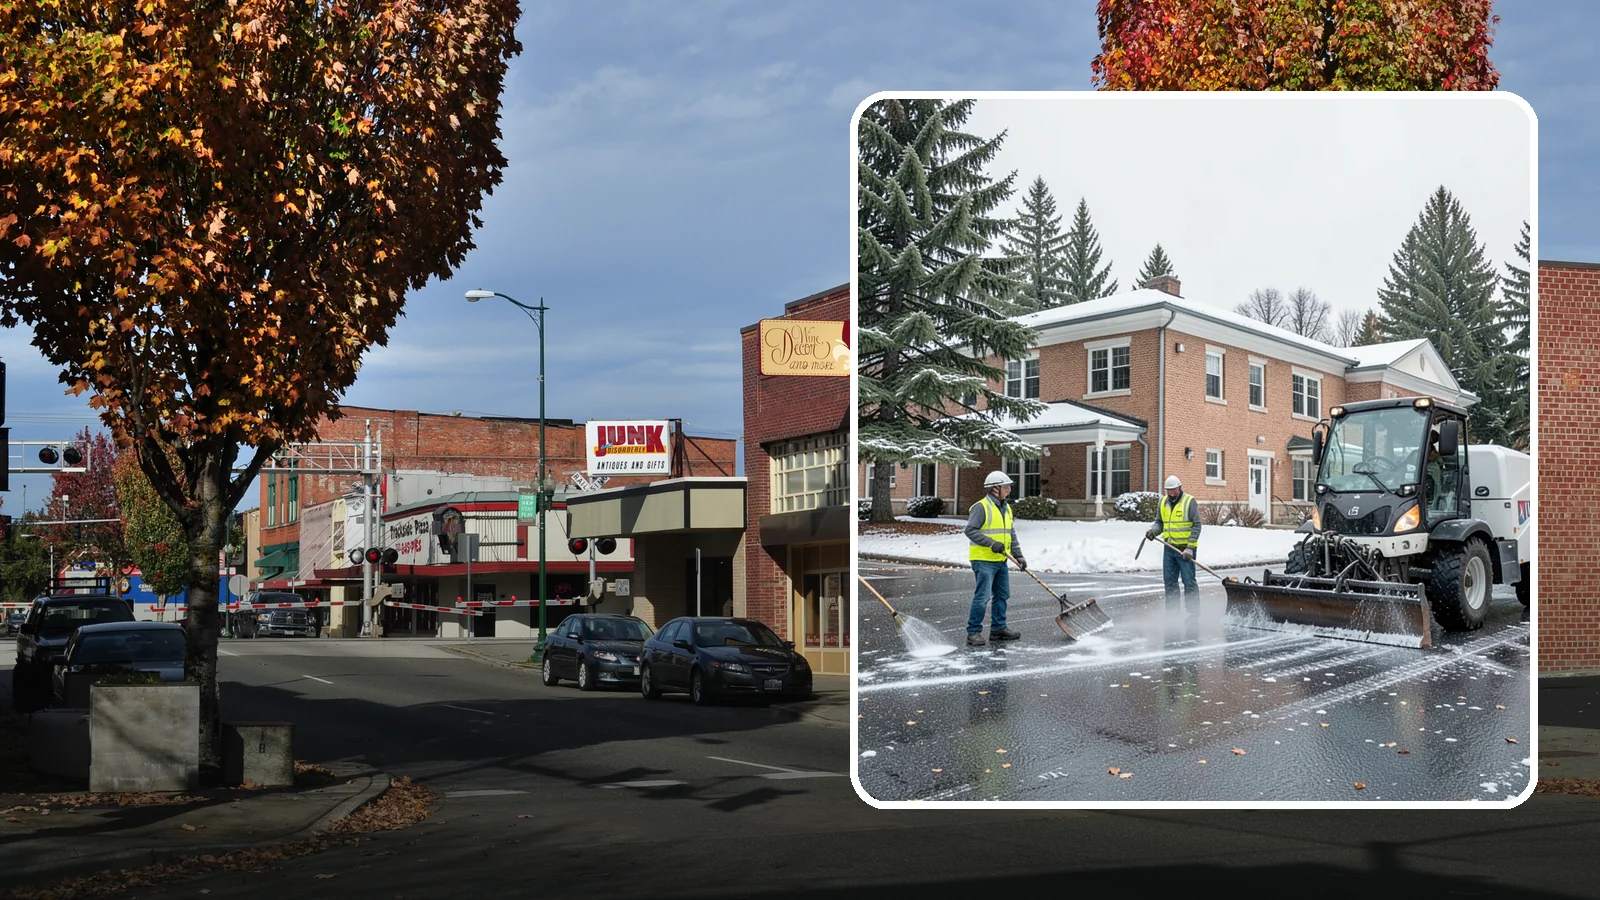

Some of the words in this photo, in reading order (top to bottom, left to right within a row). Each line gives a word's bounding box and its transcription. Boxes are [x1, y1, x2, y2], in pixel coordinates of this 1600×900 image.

[595, 425, 665, 456] JUNK
[607, 446, 646, 454] DISORDERLY
[596, 461, 628, 470] ANTIQUES
[631, 461, 644, 470] AND
[647, 460, 666, 470] GIFTS
[390, 522, 413, 540] Trackside
[414, 519, 429, 535] Pizza
